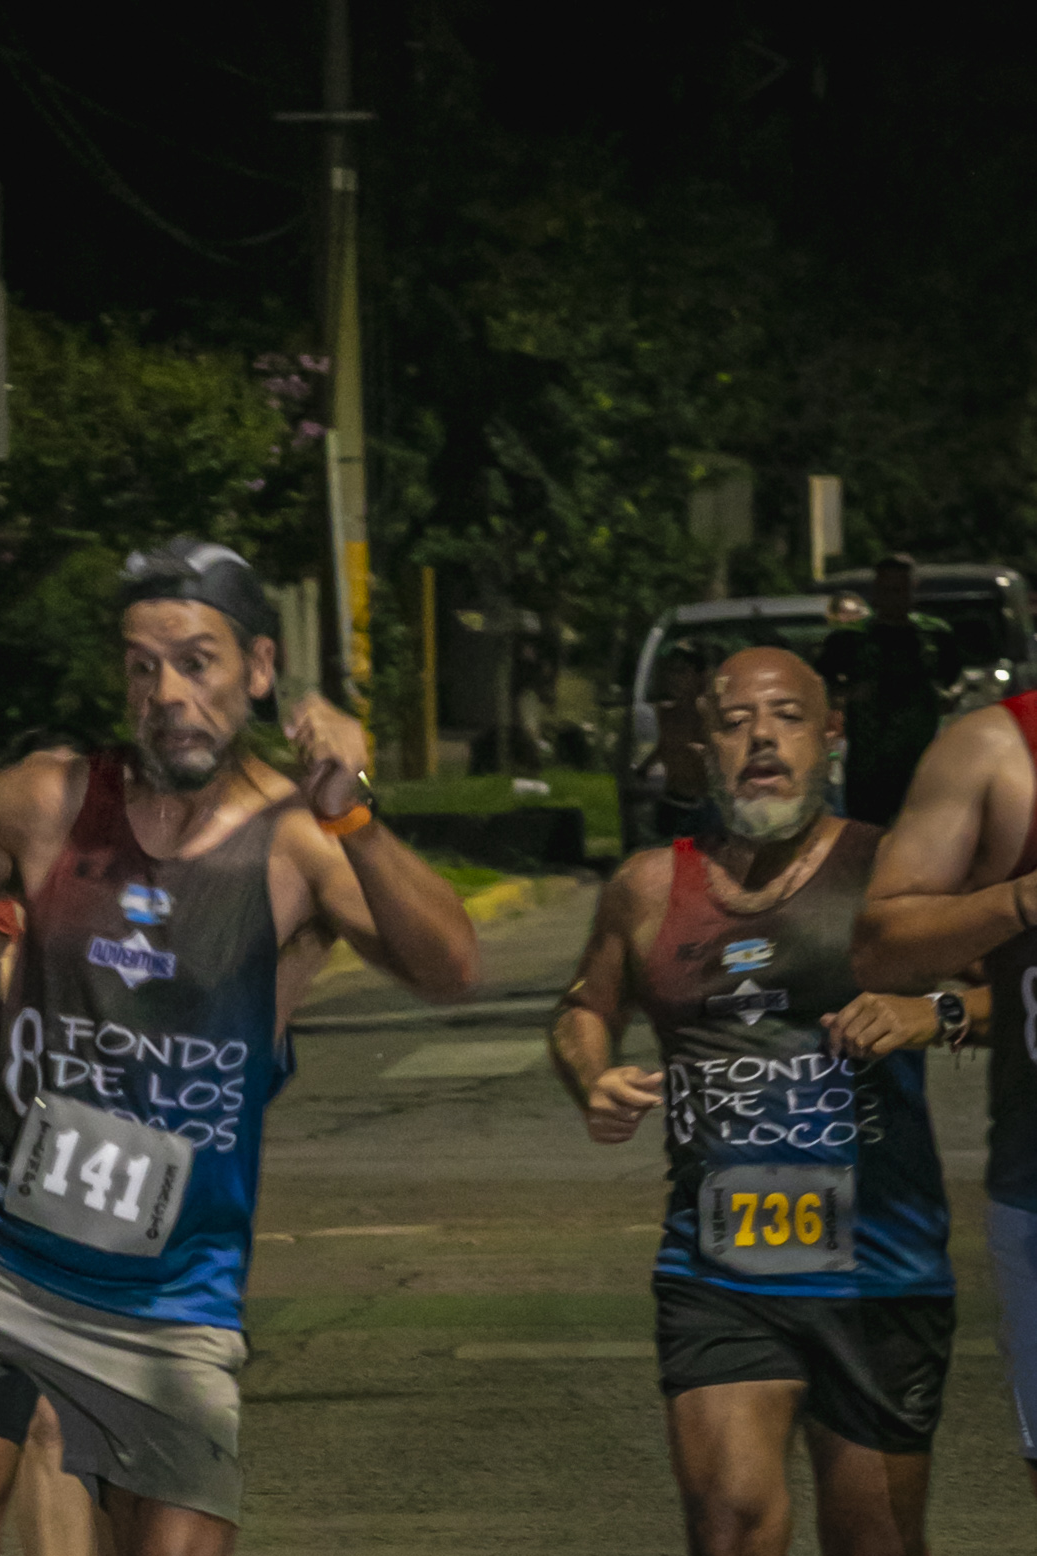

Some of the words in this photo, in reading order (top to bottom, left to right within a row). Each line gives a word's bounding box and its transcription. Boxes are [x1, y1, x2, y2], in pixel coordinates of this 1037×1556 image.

[58, 1013, 249, 1073] FONDO
[47, 1049, 125, 1098] DE
[149, 1073, 246, 1112] LOS
[697, 1086, 767, 1117] DE
[784, 1082, 880, 1115] LOS
[719, 1114, 887, 1149] LOCOS
[42, 1127, 152, 1223] 141
[730, 1191, 824, 1248] 736
